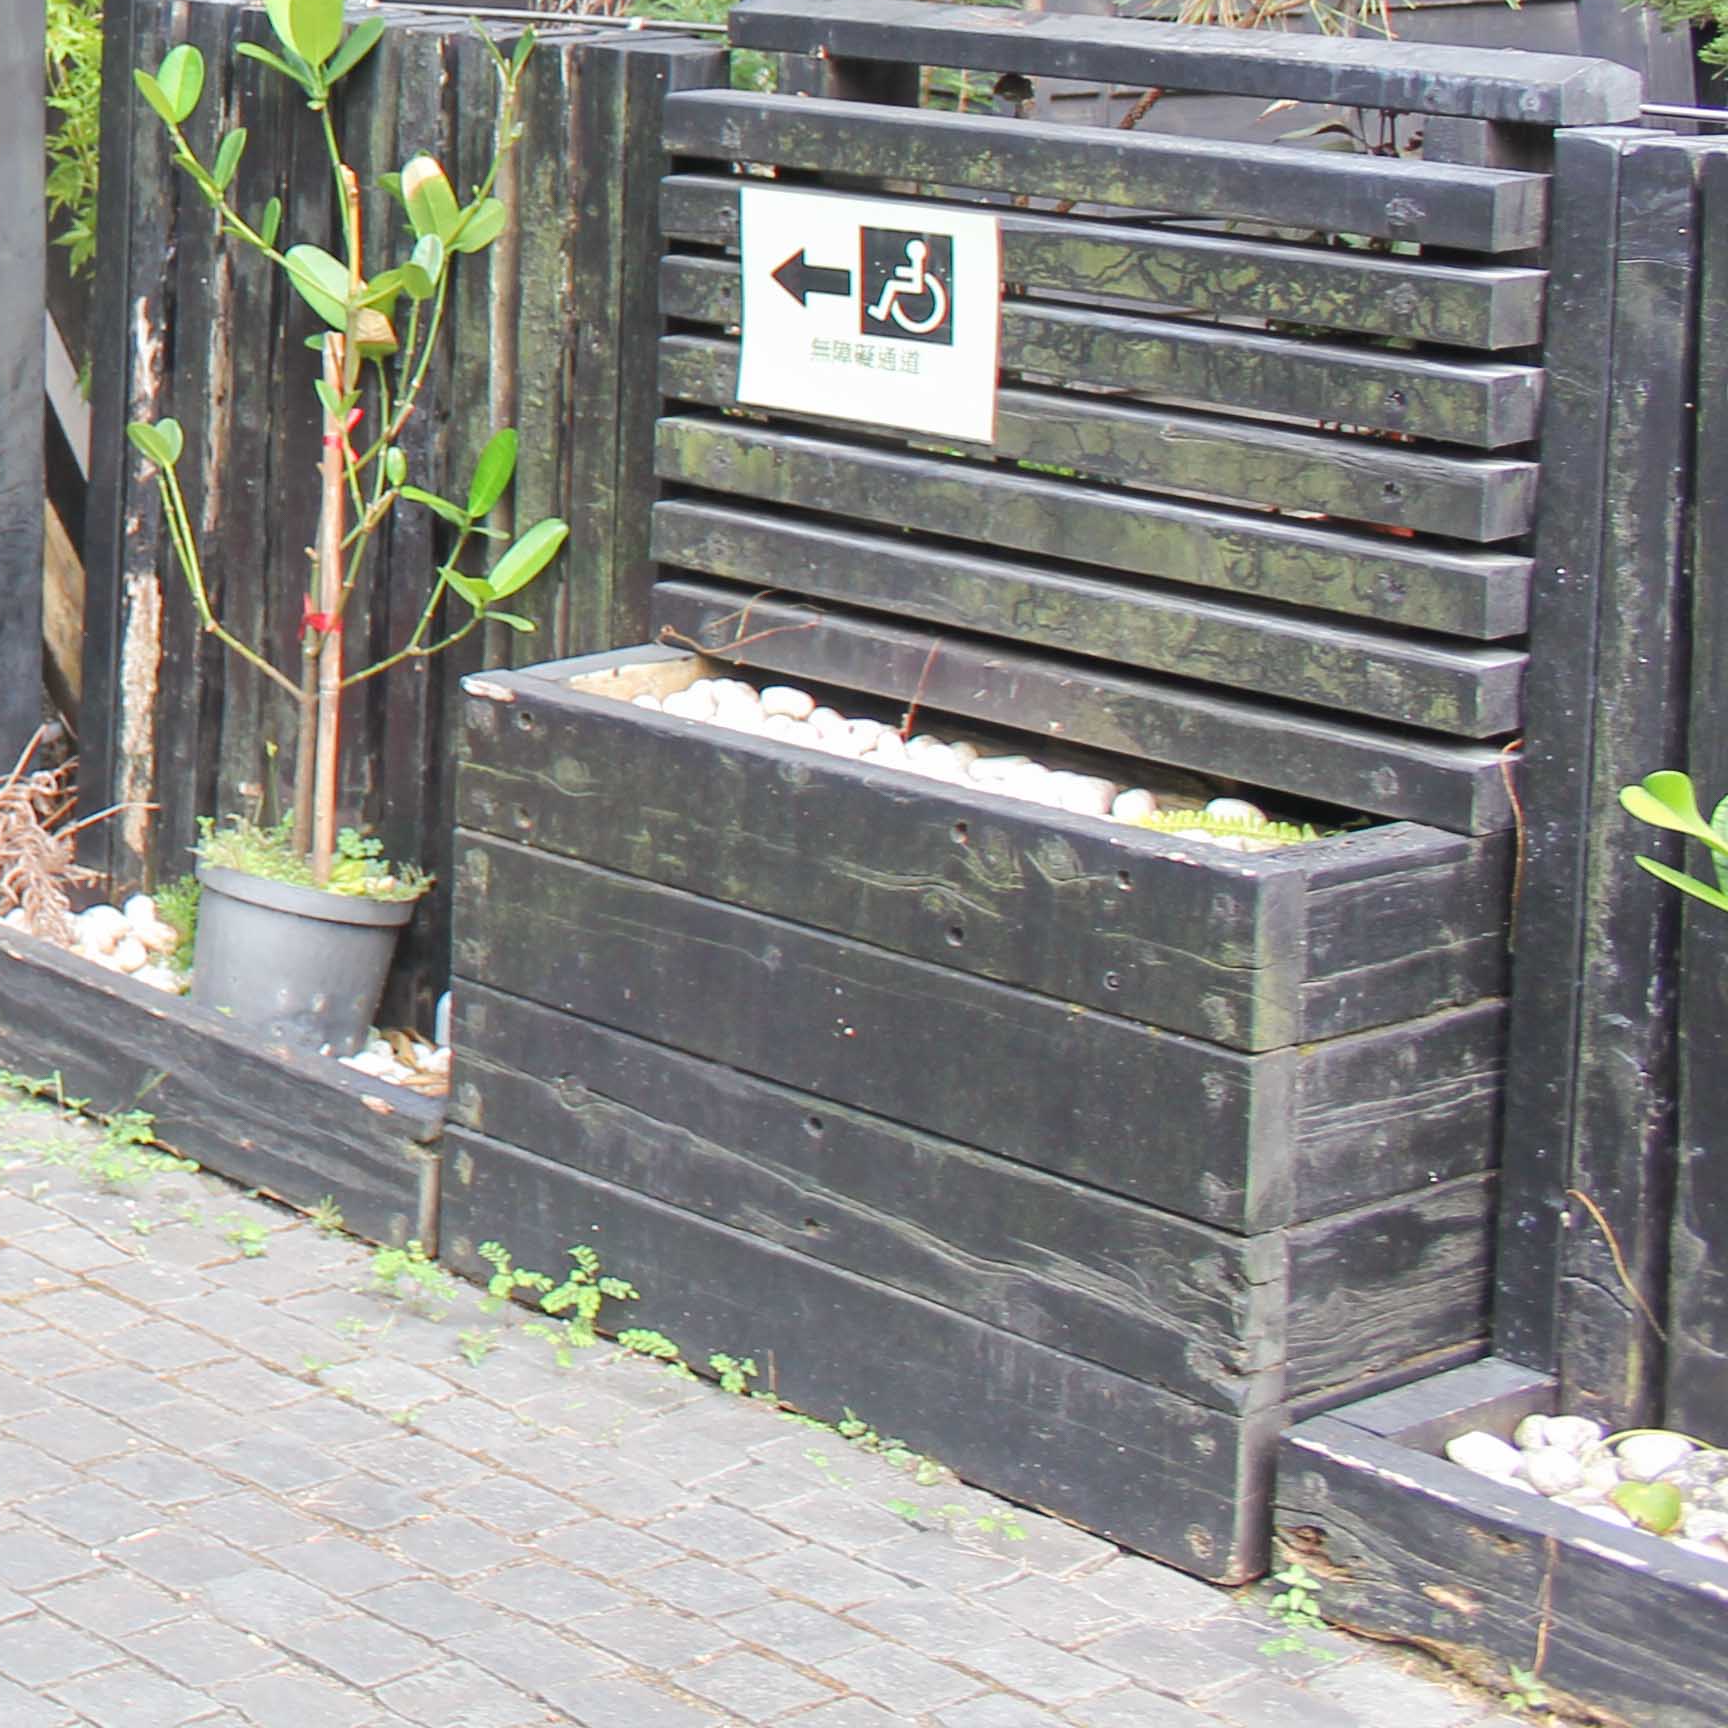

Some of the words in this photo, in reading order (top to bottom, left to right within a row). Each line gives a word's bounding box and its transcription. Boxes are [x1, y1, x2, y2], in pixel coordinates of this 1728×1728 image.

[809, 337, 920, 374] 無障礙通道
